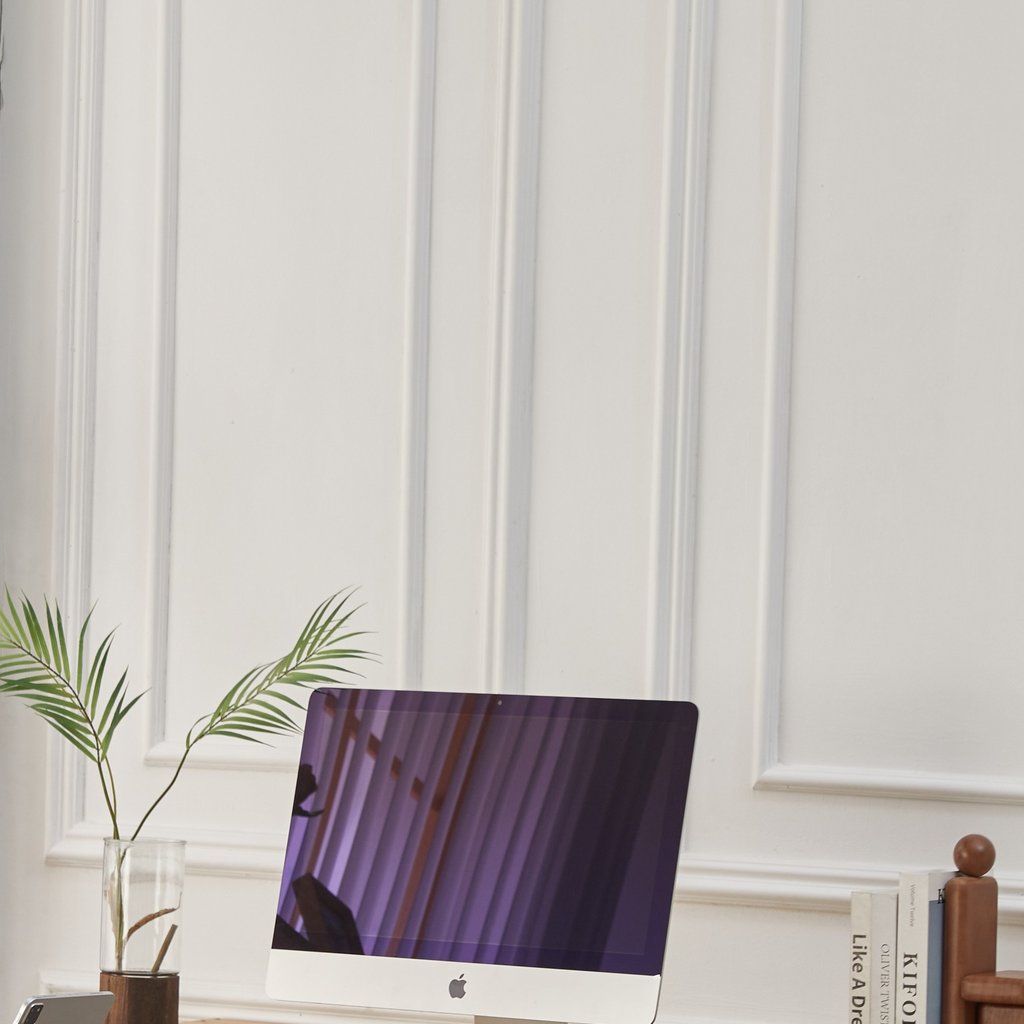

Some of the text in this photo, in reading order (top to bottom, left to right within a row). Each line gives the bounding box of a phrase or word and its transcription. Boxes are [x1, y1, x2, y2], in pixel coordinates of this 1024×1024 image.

[852, 934, 867, 973] Like
[880, 943, 890, 988] OLIVER
[851, 977, 866, 991] A
